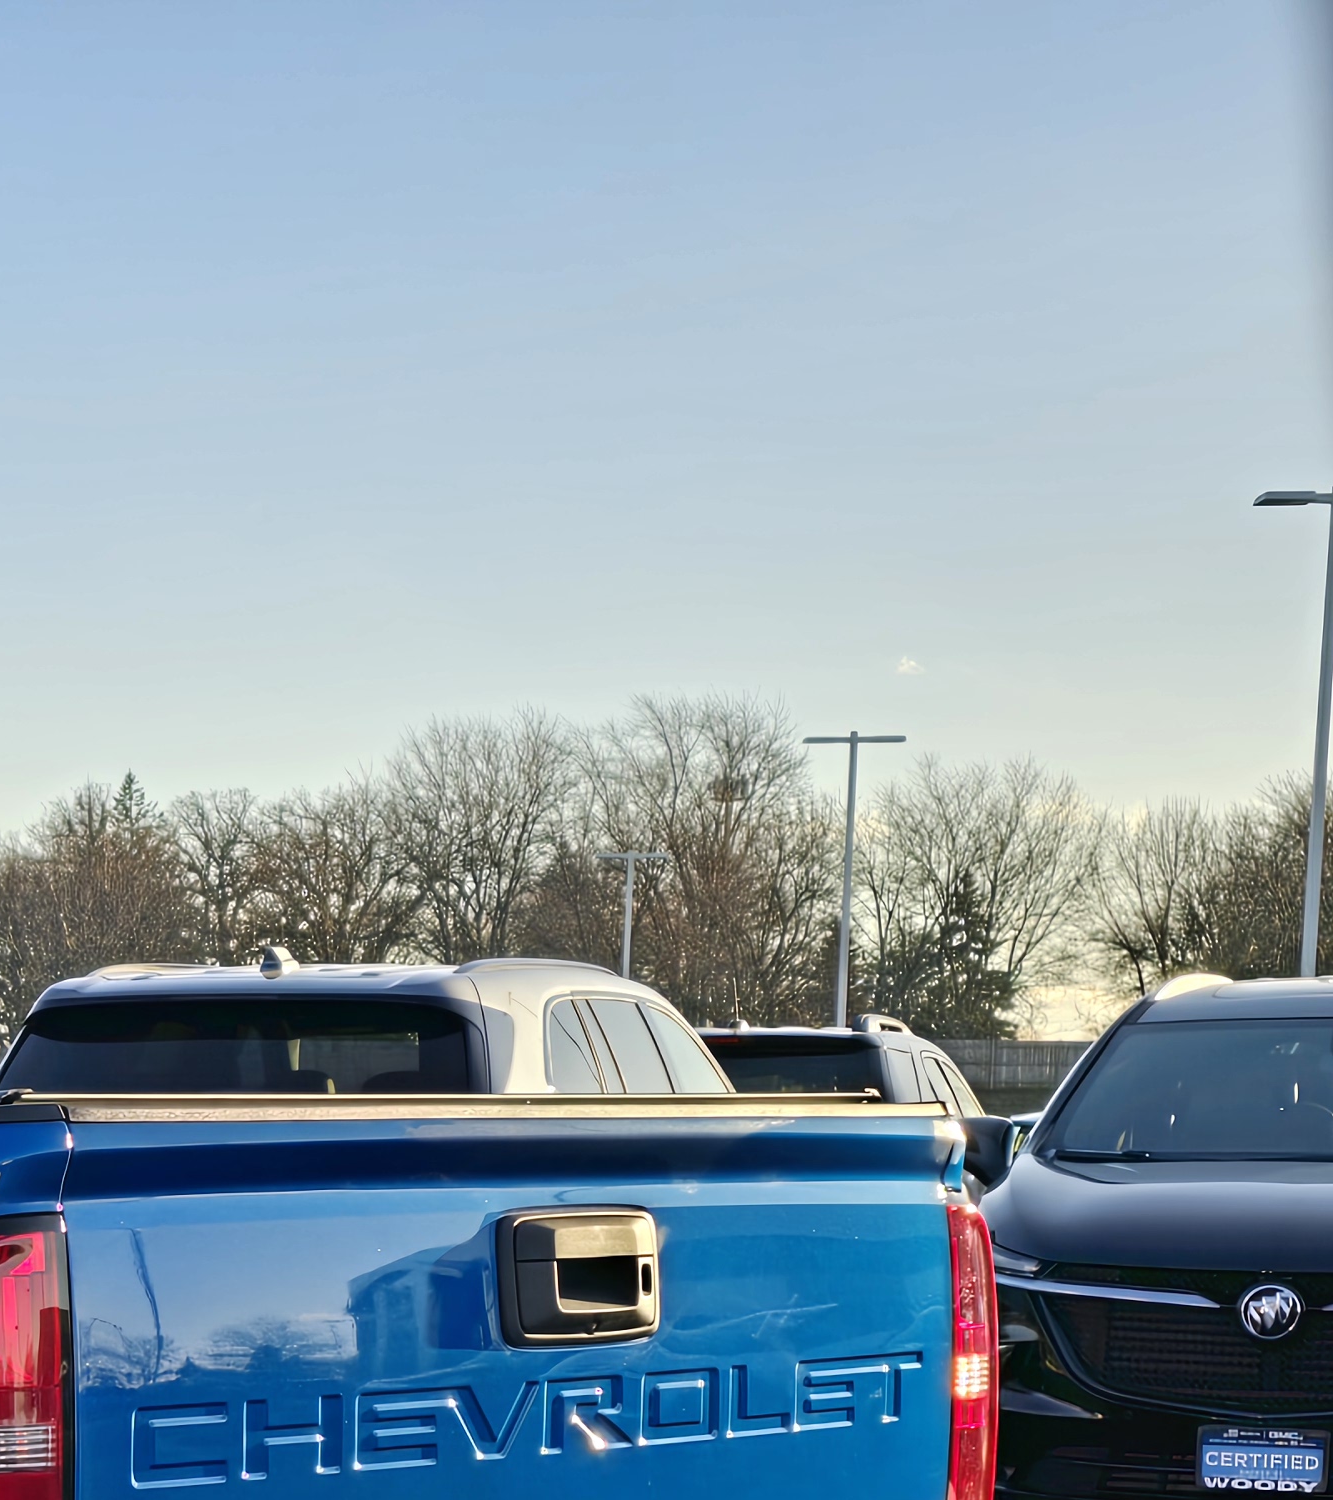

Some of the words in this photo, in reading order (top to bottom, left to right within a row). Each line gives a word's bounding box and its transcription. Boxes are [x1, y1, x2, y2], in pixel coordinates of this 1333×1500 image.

[131, 1351, 923, 1490] CHEVROLET
[1205, 1451, 1319, 1470] CERTIFIED
[1204, 1477, 1319, 1493] WOODY
